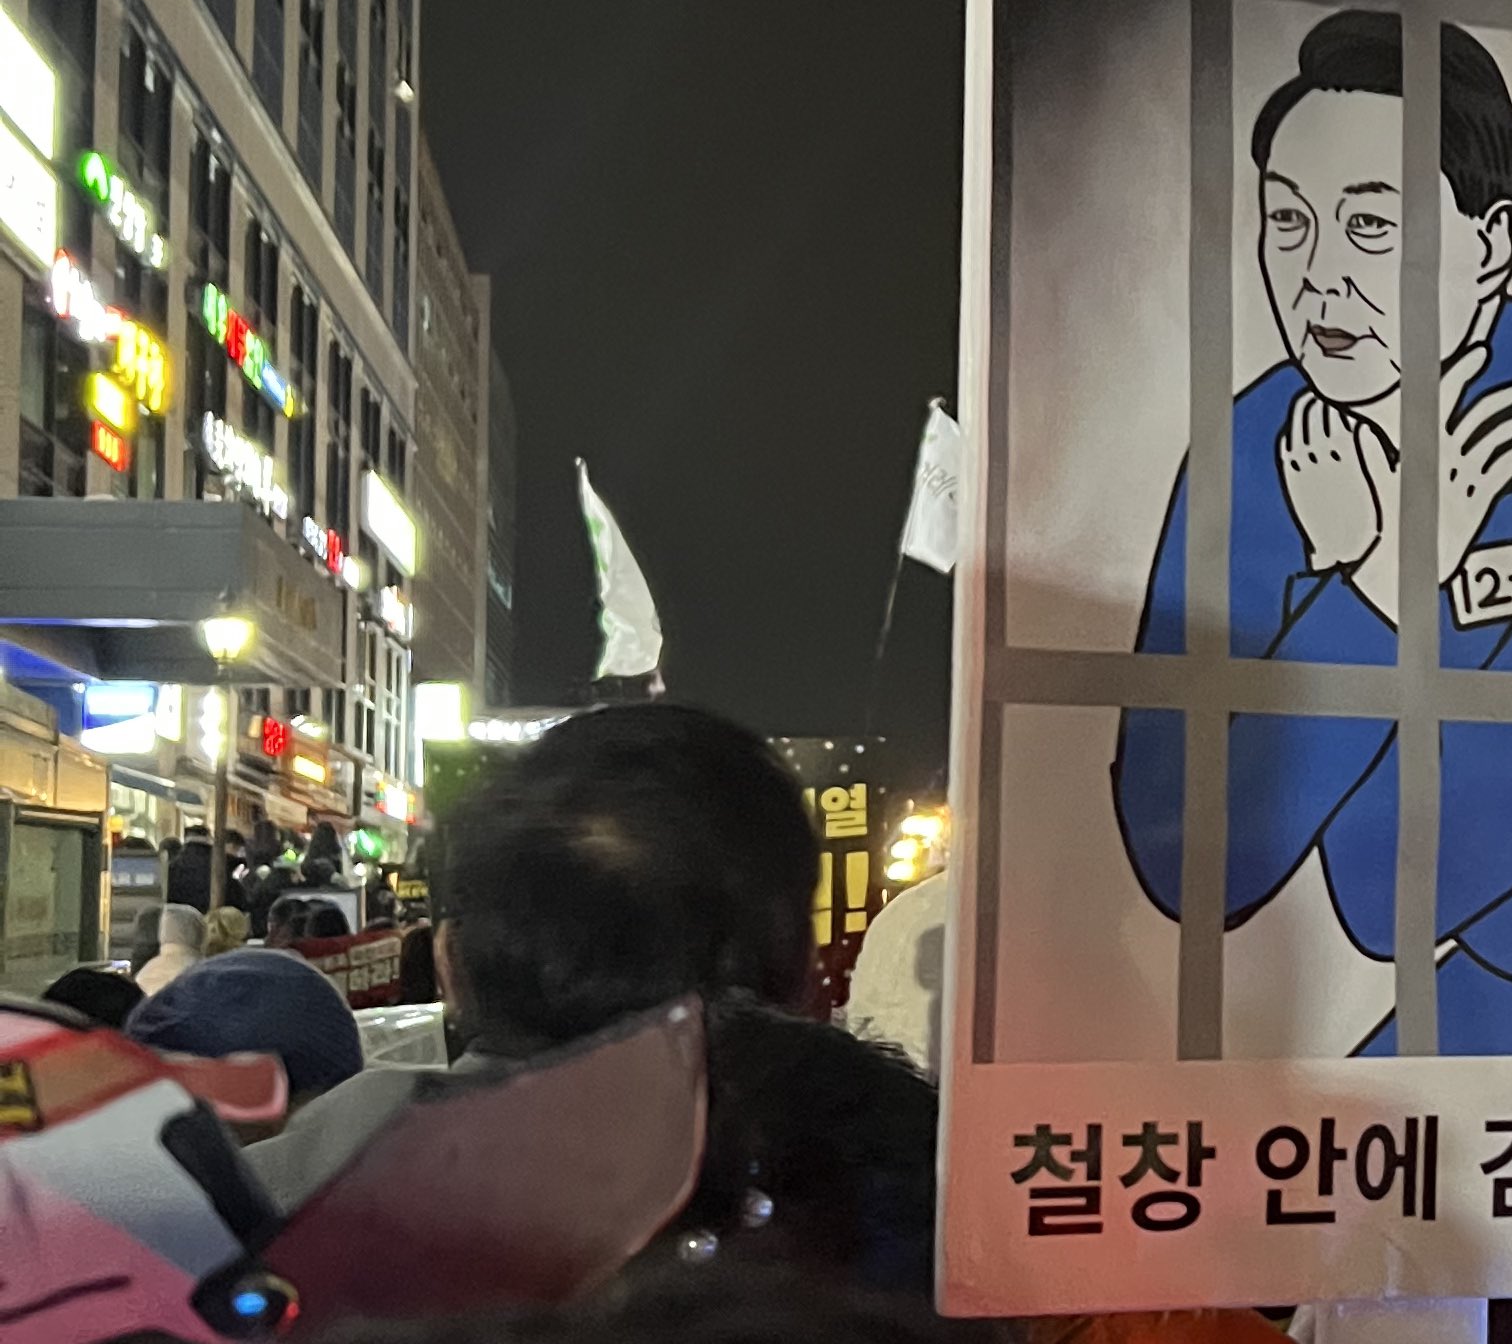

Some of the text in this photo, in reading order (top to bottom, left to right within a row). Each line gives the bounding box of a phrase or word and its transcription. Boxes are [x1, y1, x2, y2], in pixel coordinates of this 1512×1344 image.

[803, 783, 868, 838] 열
[1010, 1120, 1216, 1236] 철창
[1256, 1115, 1438, 1226] 안에
